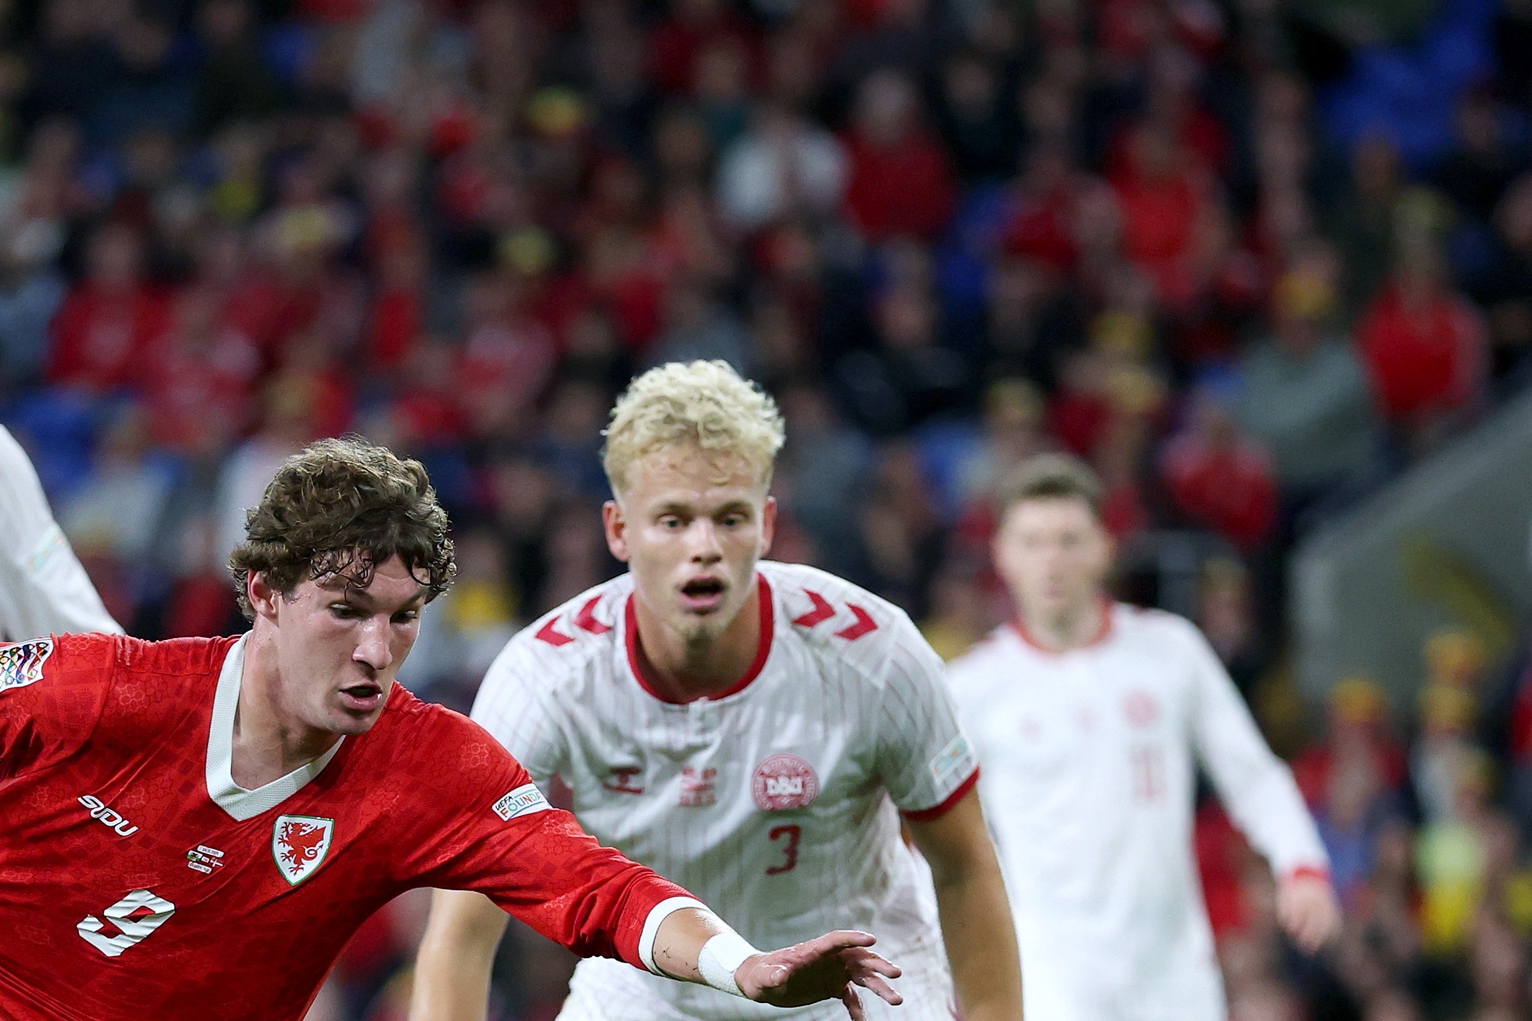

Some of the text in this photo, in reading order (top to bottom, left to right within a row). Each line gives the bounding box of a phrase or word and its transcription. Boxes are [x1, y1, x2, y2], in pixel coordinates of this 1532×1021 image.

[495, 796, 514, 811] UEFA
[765, 825, 801, 876] 3
[76, 889, 176, 955] 9
